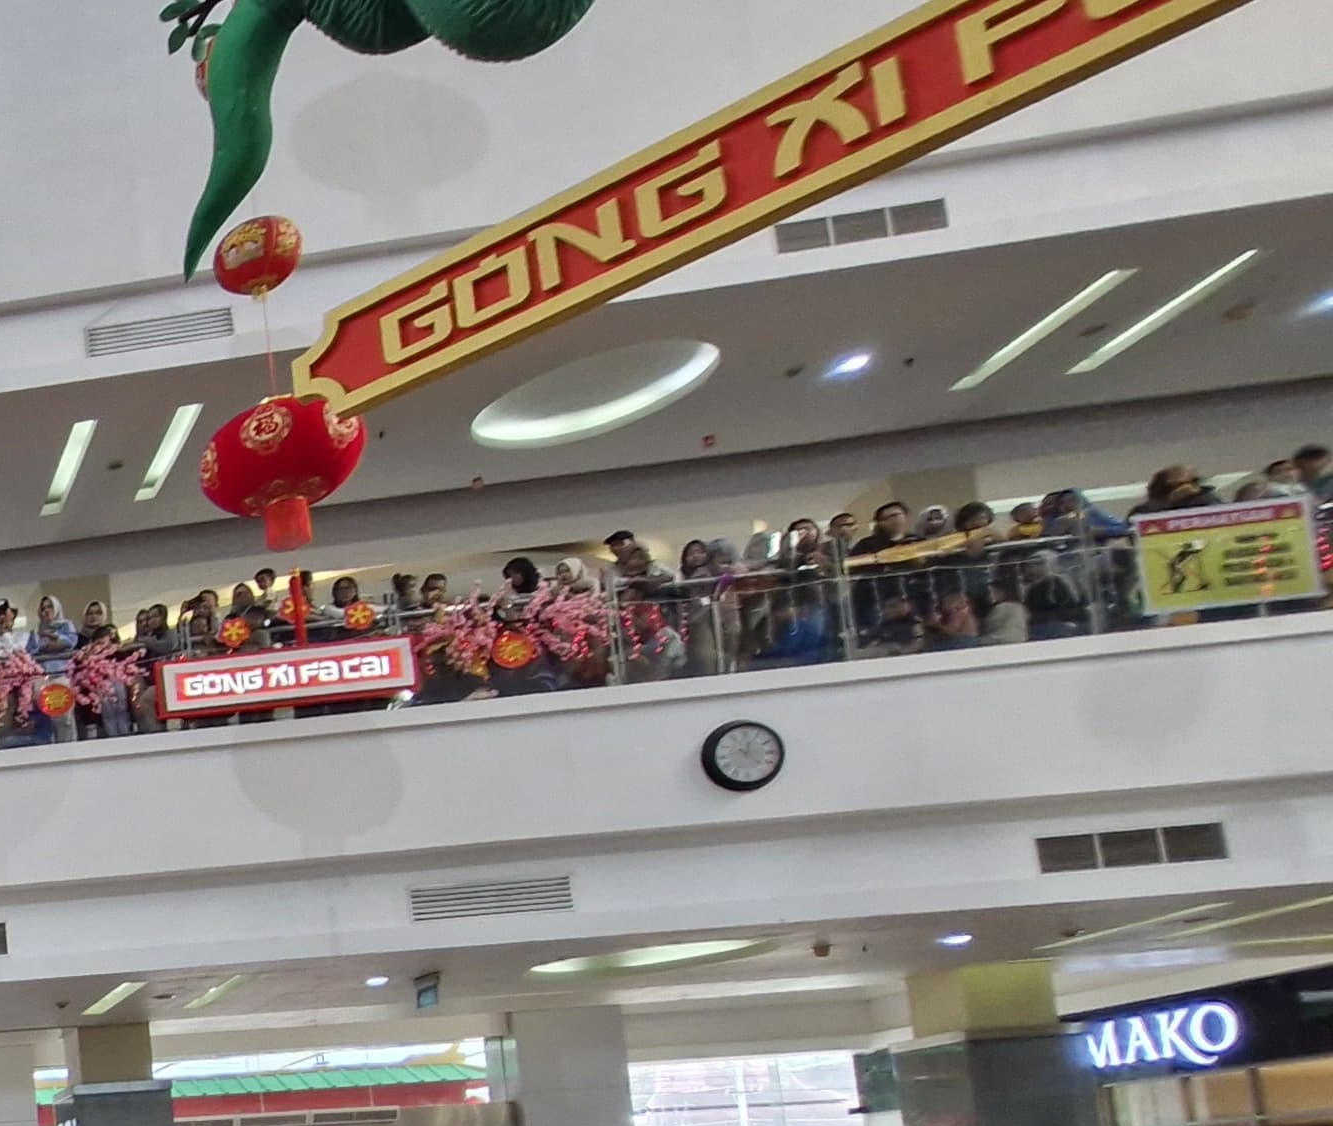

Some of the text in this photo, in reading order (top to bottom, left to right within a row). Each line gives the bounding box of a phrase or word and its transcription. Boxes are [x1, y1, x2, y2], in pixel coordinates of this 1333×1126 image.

[380, 0, 1139, 367] GONG XI F
[184, 667, 263, 697] GONG
[268, 662, 296, 688] XI
